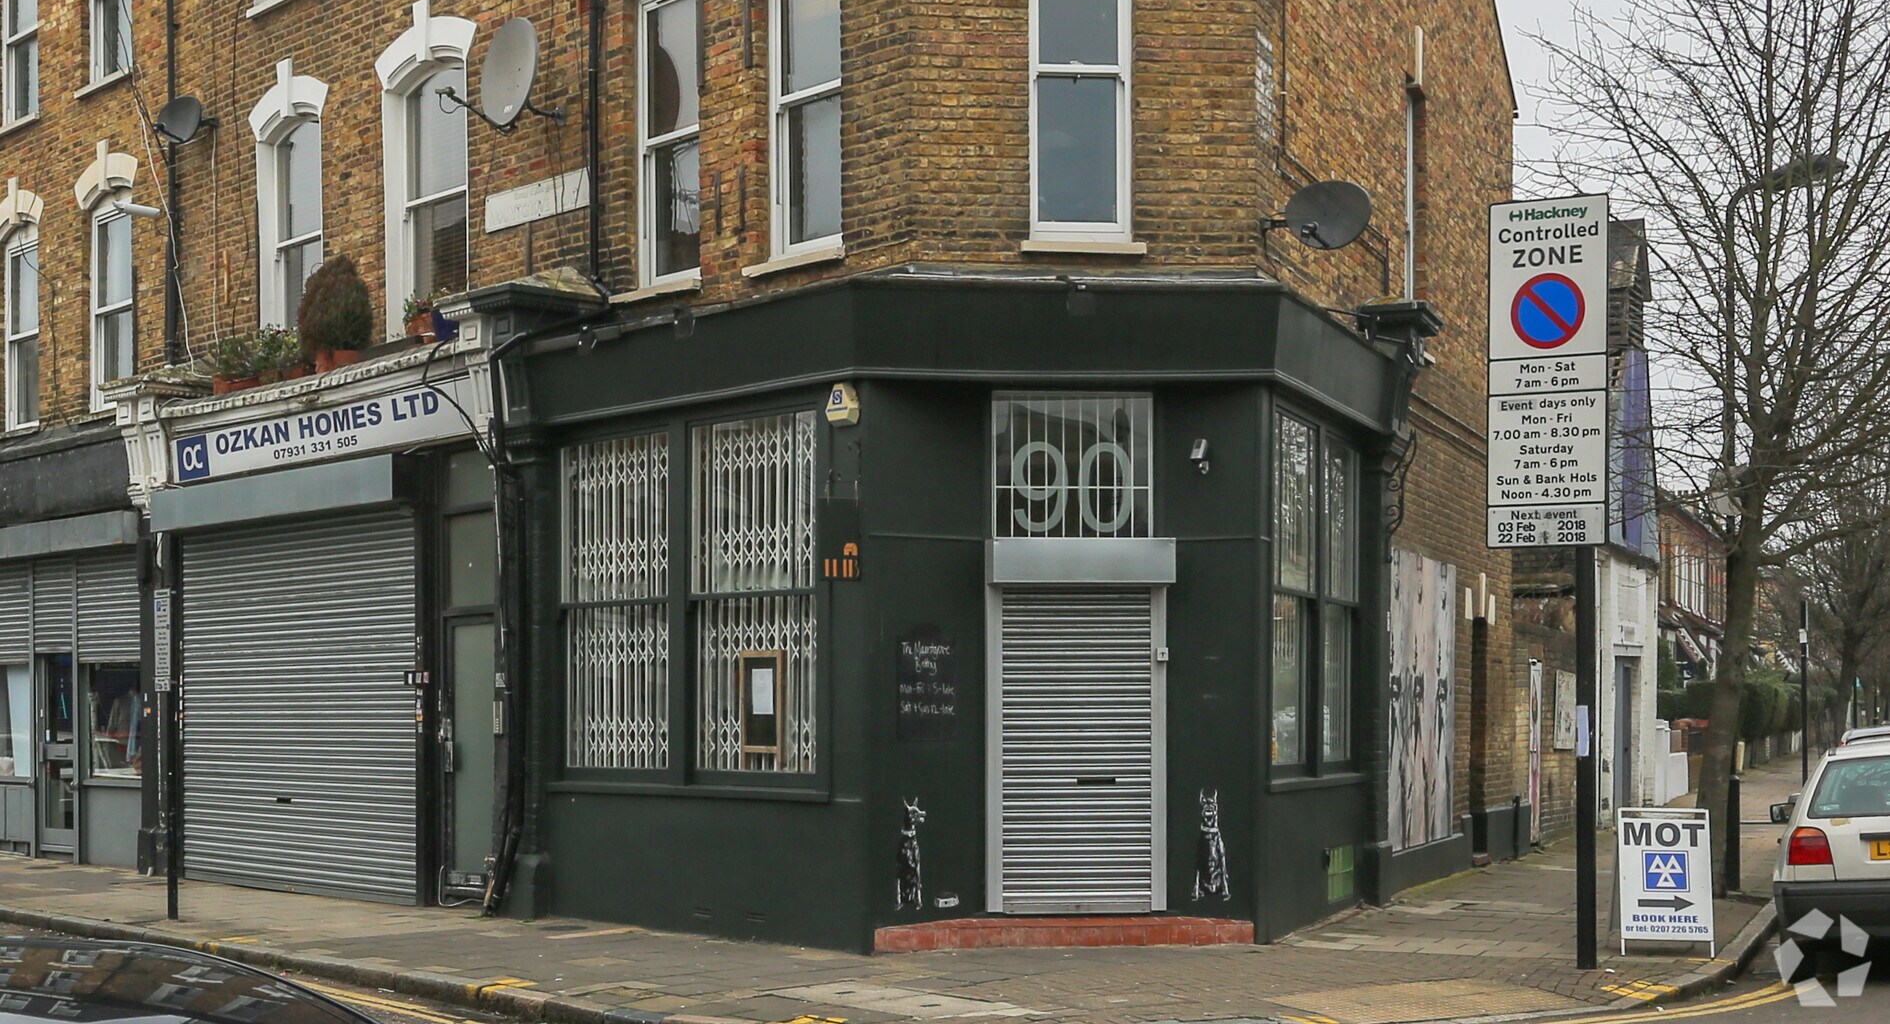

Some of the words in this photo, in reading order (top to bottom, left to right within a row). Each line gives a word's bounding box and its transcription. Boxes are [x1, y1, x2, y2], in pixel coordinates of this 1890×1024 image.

[1525, 206, 1588, 221] Hackney
[1499, 221, 1599, 244] Controlled
[1513, 244, 1583, 268] ZONE
[1520, 364, 1545, 374] Mon
[1554, 361, 1576, 372] Sat
[1515, 378, 1522, 388] 7
[1524, 378, 1541, 388] am
[1551, 376, 1558, 386] 6
[1561, 377, 1579, 387] pm
[1500, 400, 1533, 411] Event
[1539, 398, 1567, 409] days
[1570, 396, 1596, 408] only
[215, 420, 290, 455] OZKAN
[298, 402, 382, 439] HOMES
[391, 391, 439, 421] LTD
[1521, 414, 1547, 424] Mon
[1556, 412, 1572, 423] Fri
[1493, 430, 1520, 440] 7.00
[1524, 431, 1541, 439] am
[1550, 426, 1580, 438] 8.30
[1582, 428, 1600, 438] pm
[273, 445, 306, 460] 07931
[311, 440, 331, 453] 331
[337, 435, 358, 449] 505
[1520, 444, 1574, 455] Saturday
[1514, 460, 1521, 469] 7
[1523, 461, 1540, 469] am
[1550, 458, 1557, 468] 6
[1560, 458, 1578, 469] pm
[1496, 476, 1519, 486] Sun
[1524, 474, 1531, 484] &
[1536, 474, 1565, 484] Bank
[1570, 472, 1597, 482] Hols
[1012, 441, 1134, 533] 90
[1501, 490, 1532, 500] Noon
[1542, 488, 1570, 498] 4.30
[1574, 488, 1592, 498] pm
[1511, 510, 1540, 520] Next
[1544, 510, 1577, 519] event
[1498, 522, 1514, 532] 03
[1516, 522, 1536, 532] Feb
[1558, 520, 1586, 530] 2018
[1498, 534, 1513, 544] 22
[1516, 533, 1536, 543] Feb
[1558, 532, 1586, 542] 2018
[1624, 822, 1706, 847] MOT
[1632, 914, 1666, 922] BOOK
[1668, 915, 1699, 924] HERE
[1688, 926, 1708, 934] 5765
